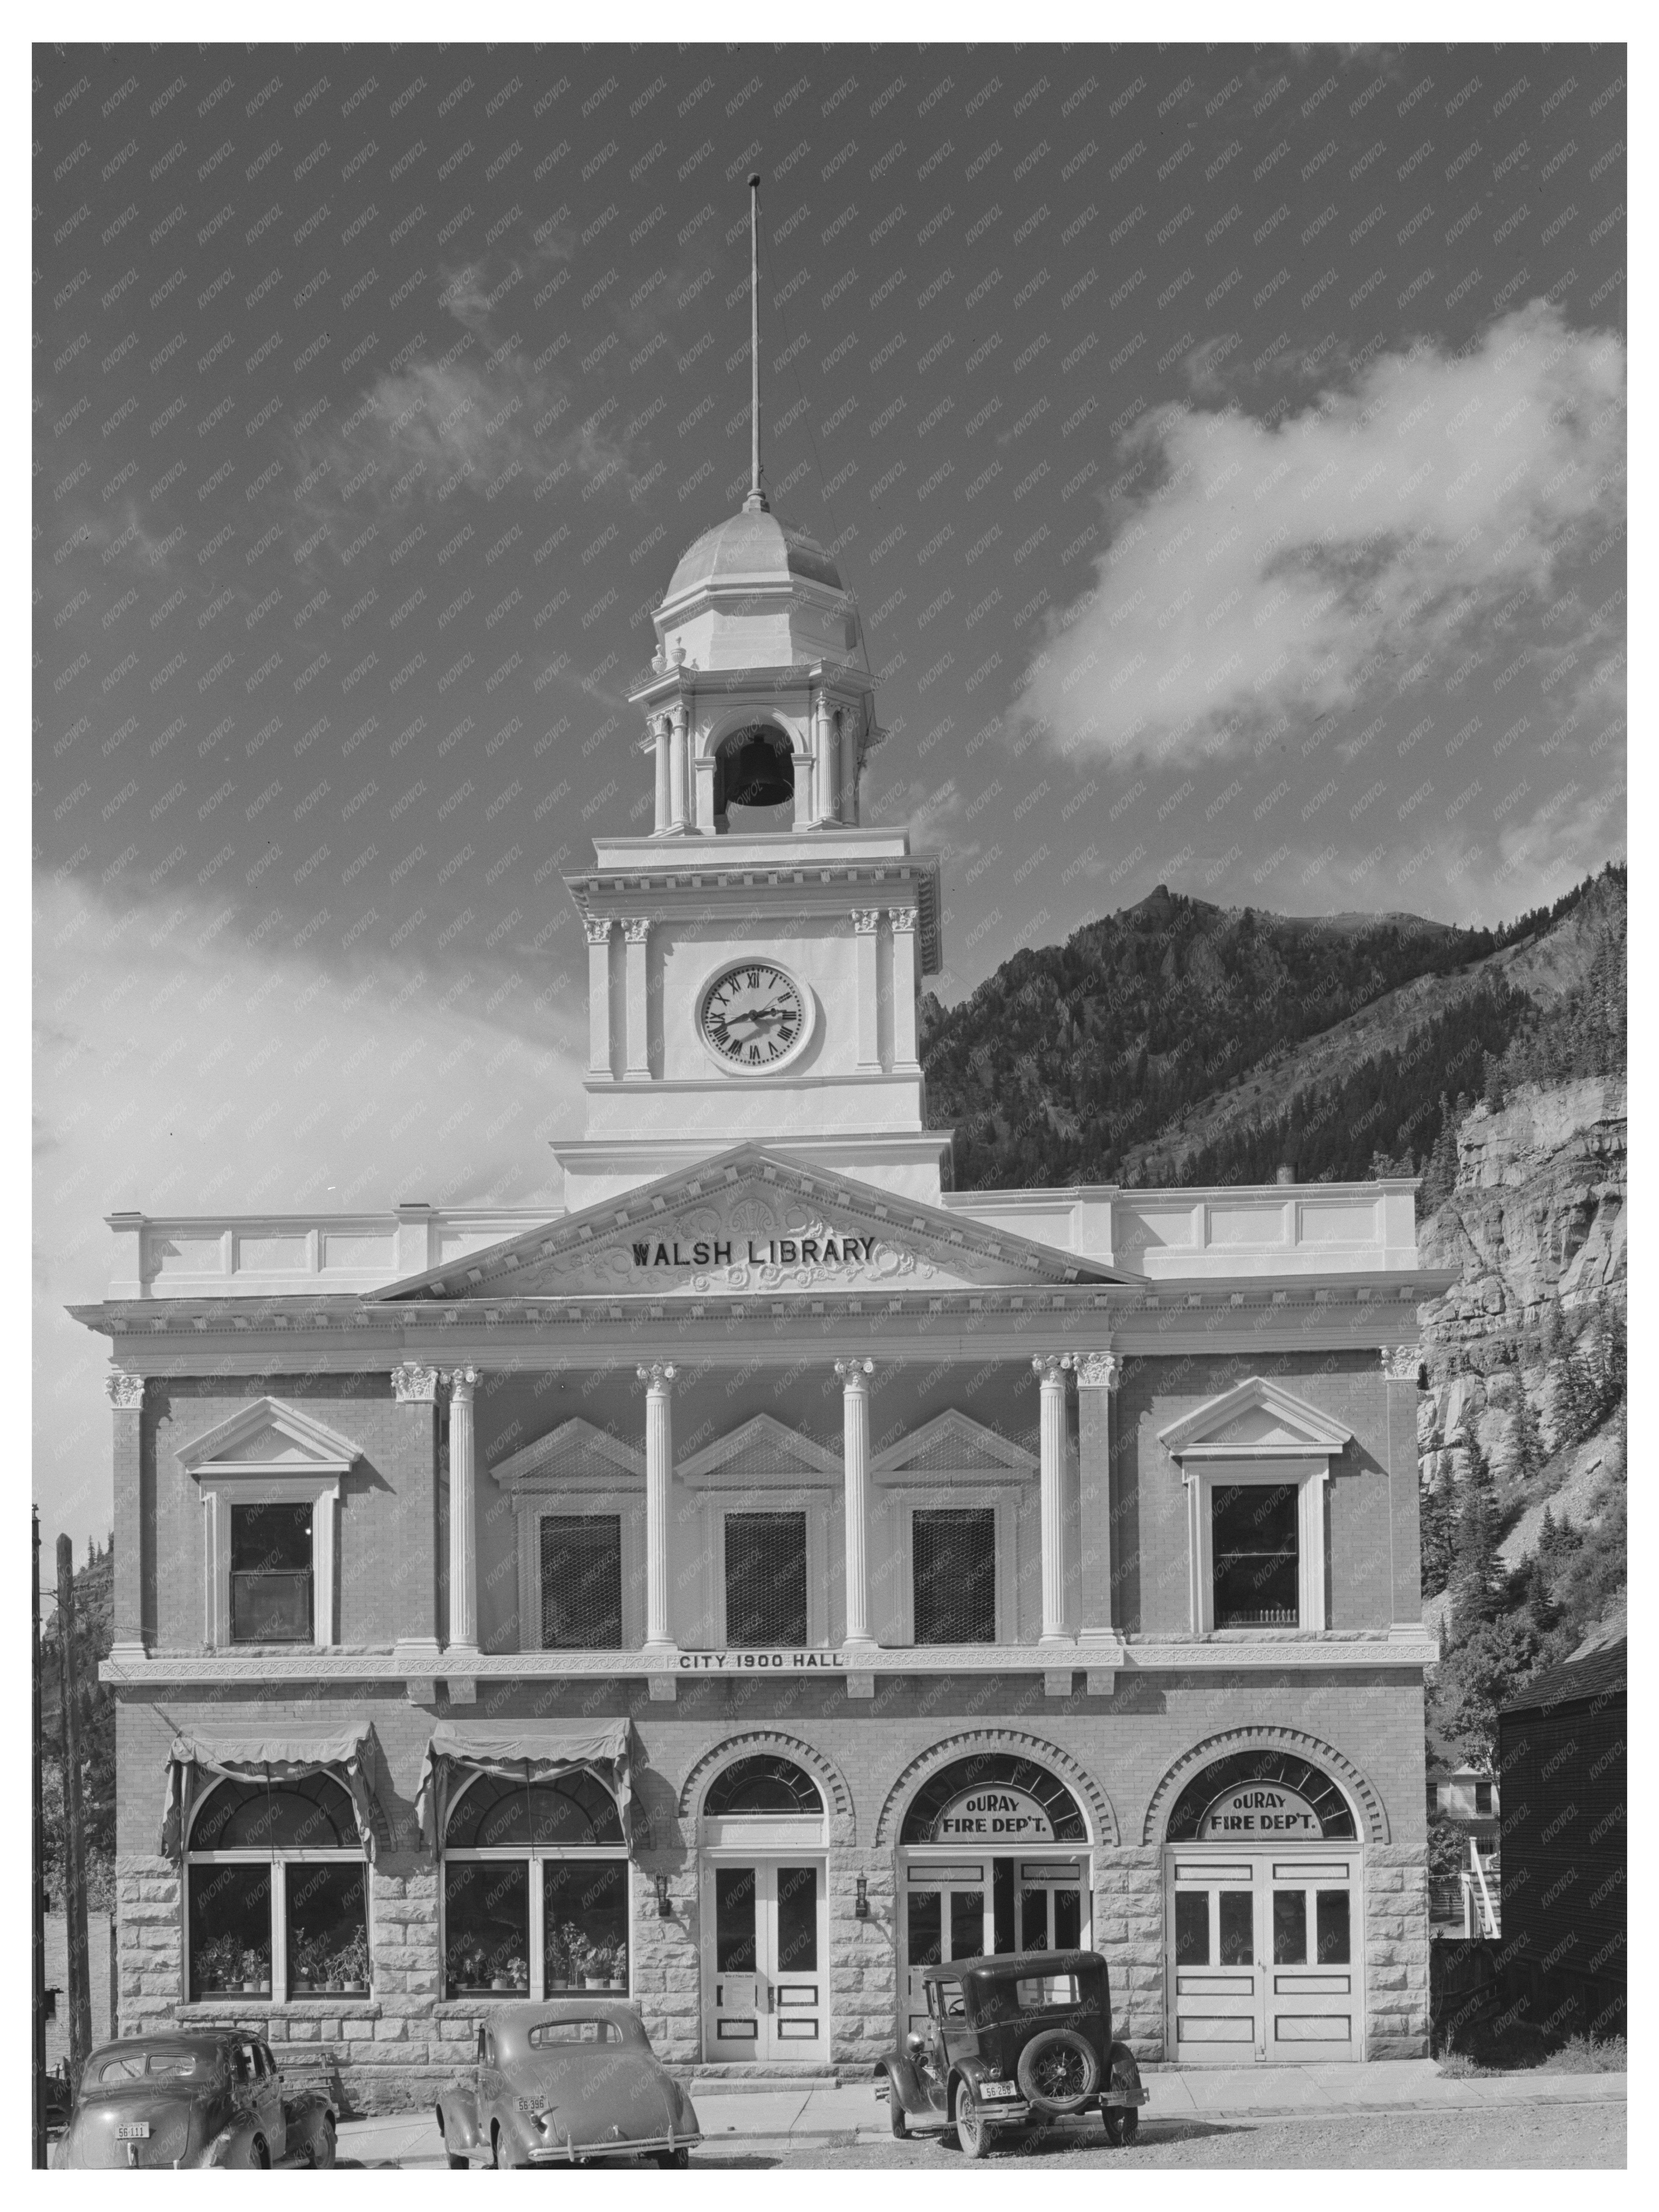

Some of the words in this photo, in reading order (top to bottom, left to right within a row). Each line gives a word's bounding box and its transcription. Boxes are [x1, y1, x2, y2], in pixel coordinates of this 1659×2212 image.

[632, 1241, 731, 1266] WALSH
[748, 1237, 875, 1263] LIBRARY
[680, 1656, 726, 1668] CITY
[737, 1654, 783, 1667] 1900
[793, 1654, 843, 1667] HALL
[943, 1818, 987, 1833] FIRE
[1211, 1815, 1254, 1830] FIRE
